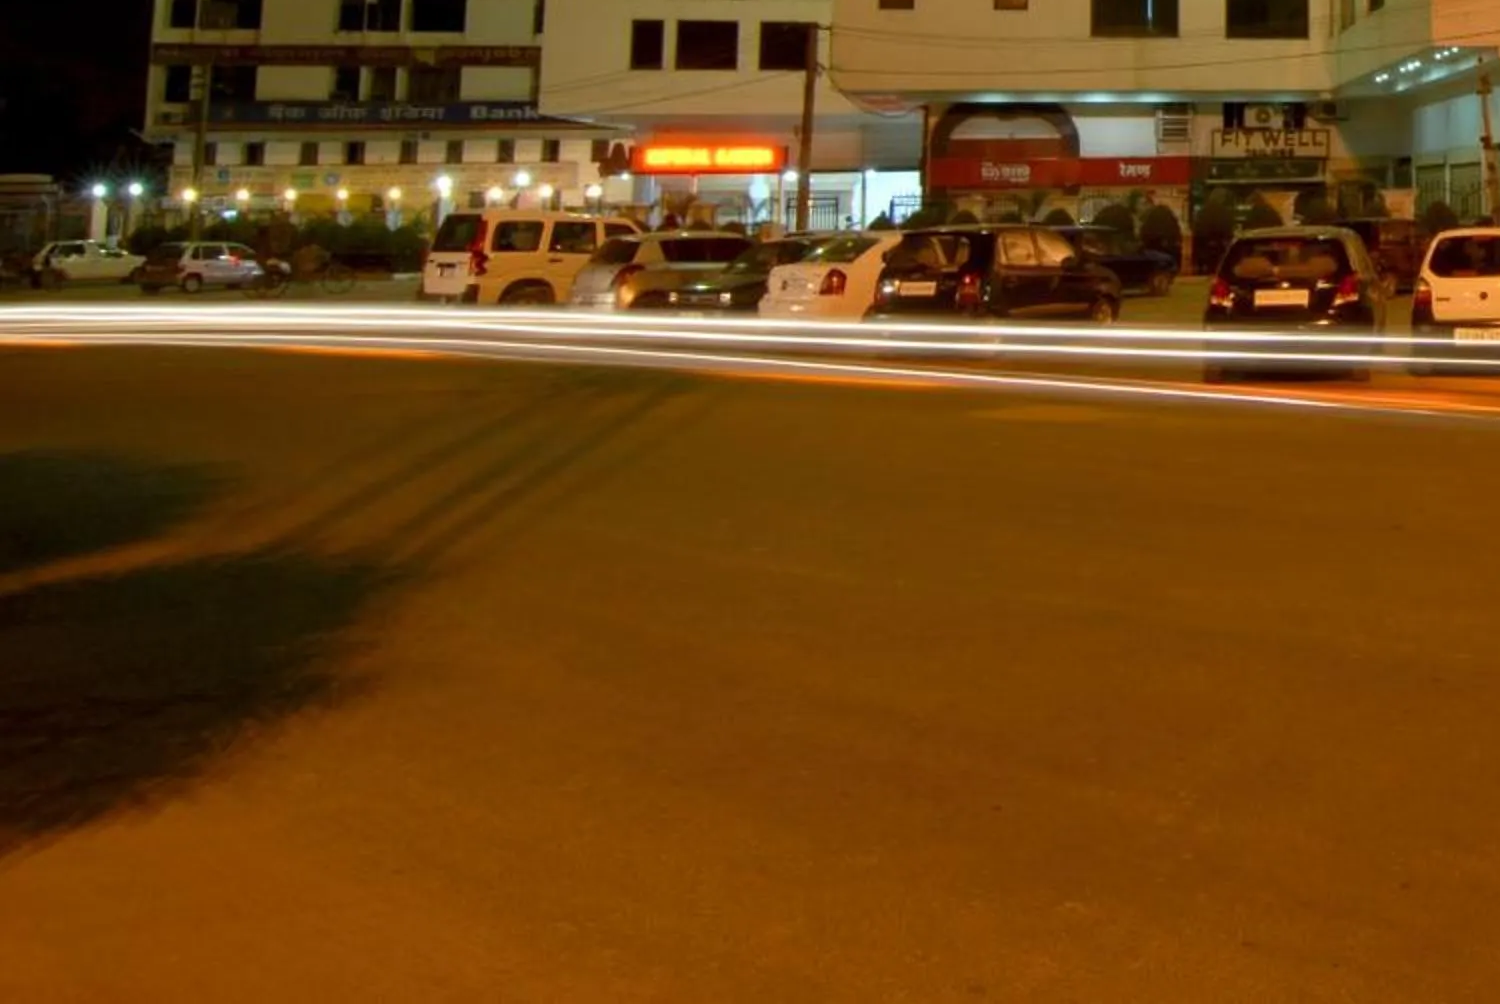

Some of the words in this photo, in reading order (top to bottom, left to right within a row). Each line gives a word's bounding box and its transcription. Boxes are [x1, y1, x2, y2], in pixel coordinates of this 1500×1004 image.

[468, 104, 540, 120] Bank
[1221, 129, 1255, 148] FIT
[1261, 129, 1325, 148] WELL
